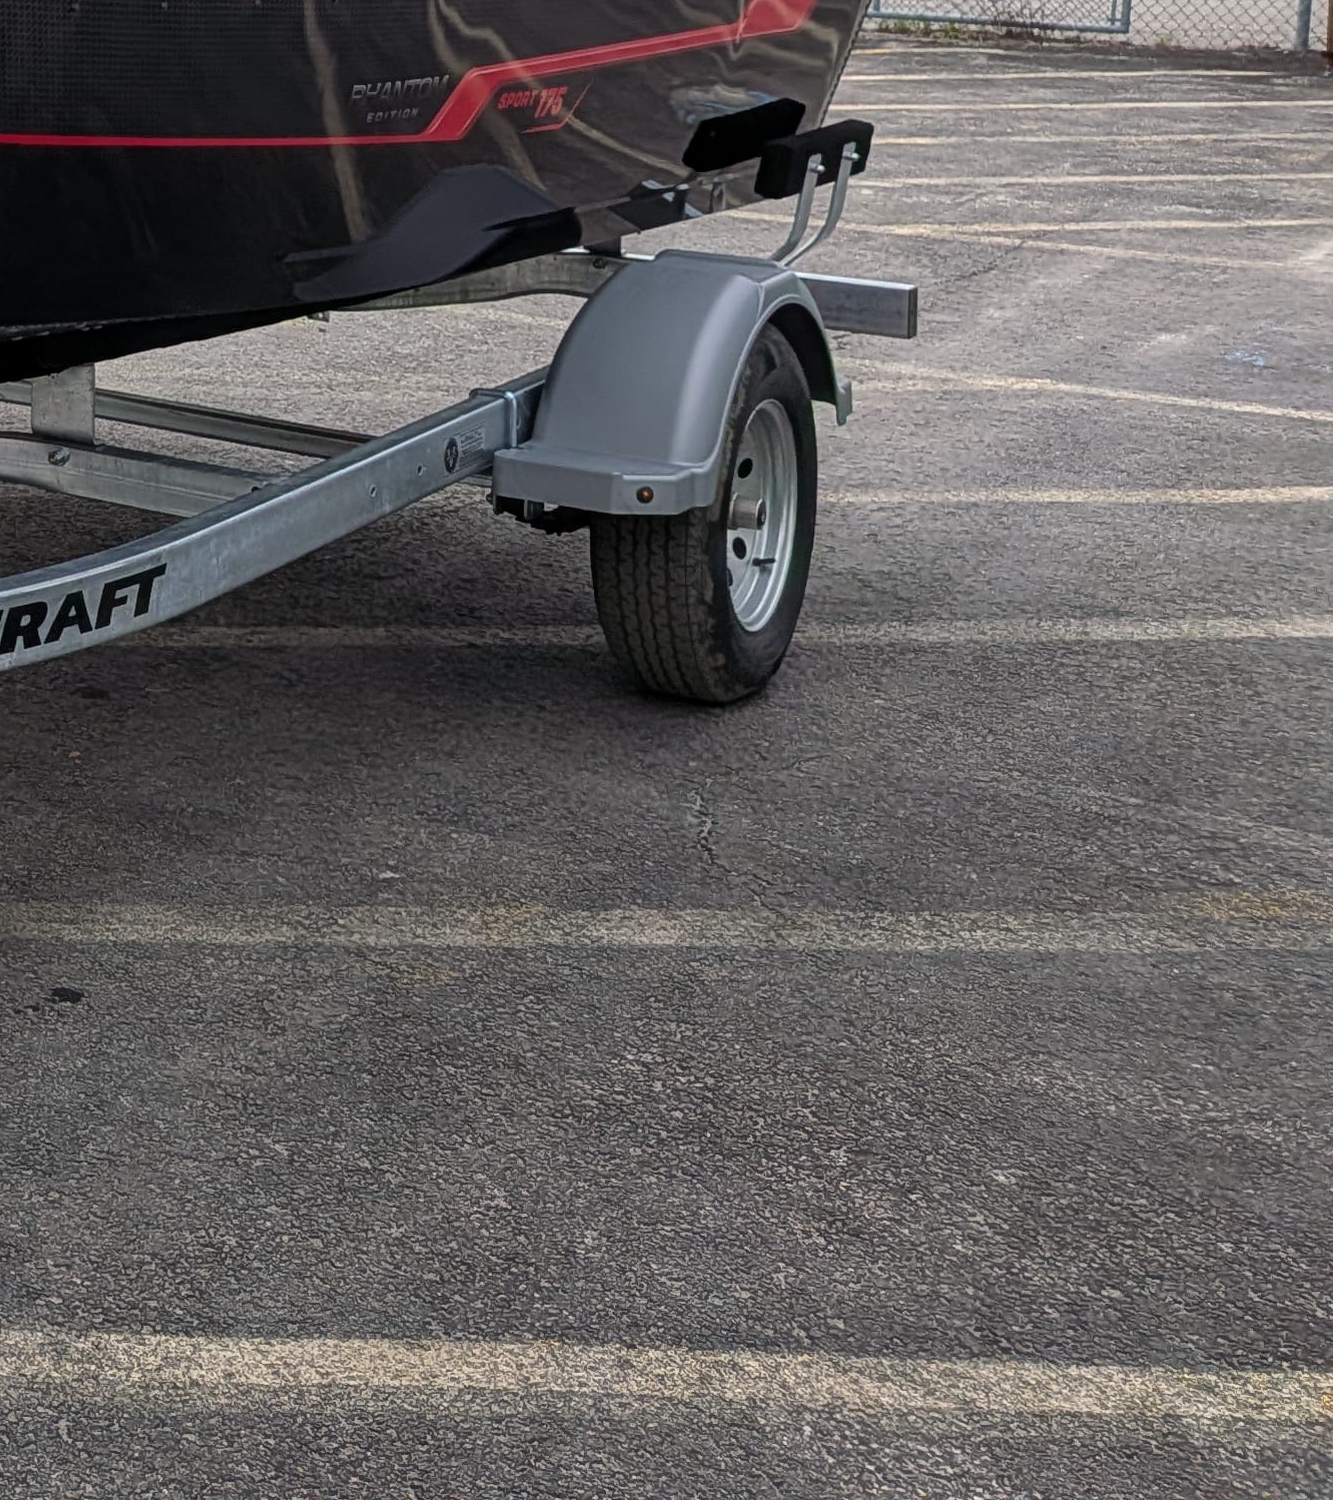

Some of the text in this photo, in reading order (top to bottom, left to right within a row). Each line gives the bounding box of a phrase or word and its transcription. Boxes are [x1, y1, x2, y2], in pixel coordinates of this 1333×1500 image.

[351, 75, 450, 100] PHANTOM
[497, 86, 569, 119] SPORT 175
[366, 107, 420, 124] EDITION
